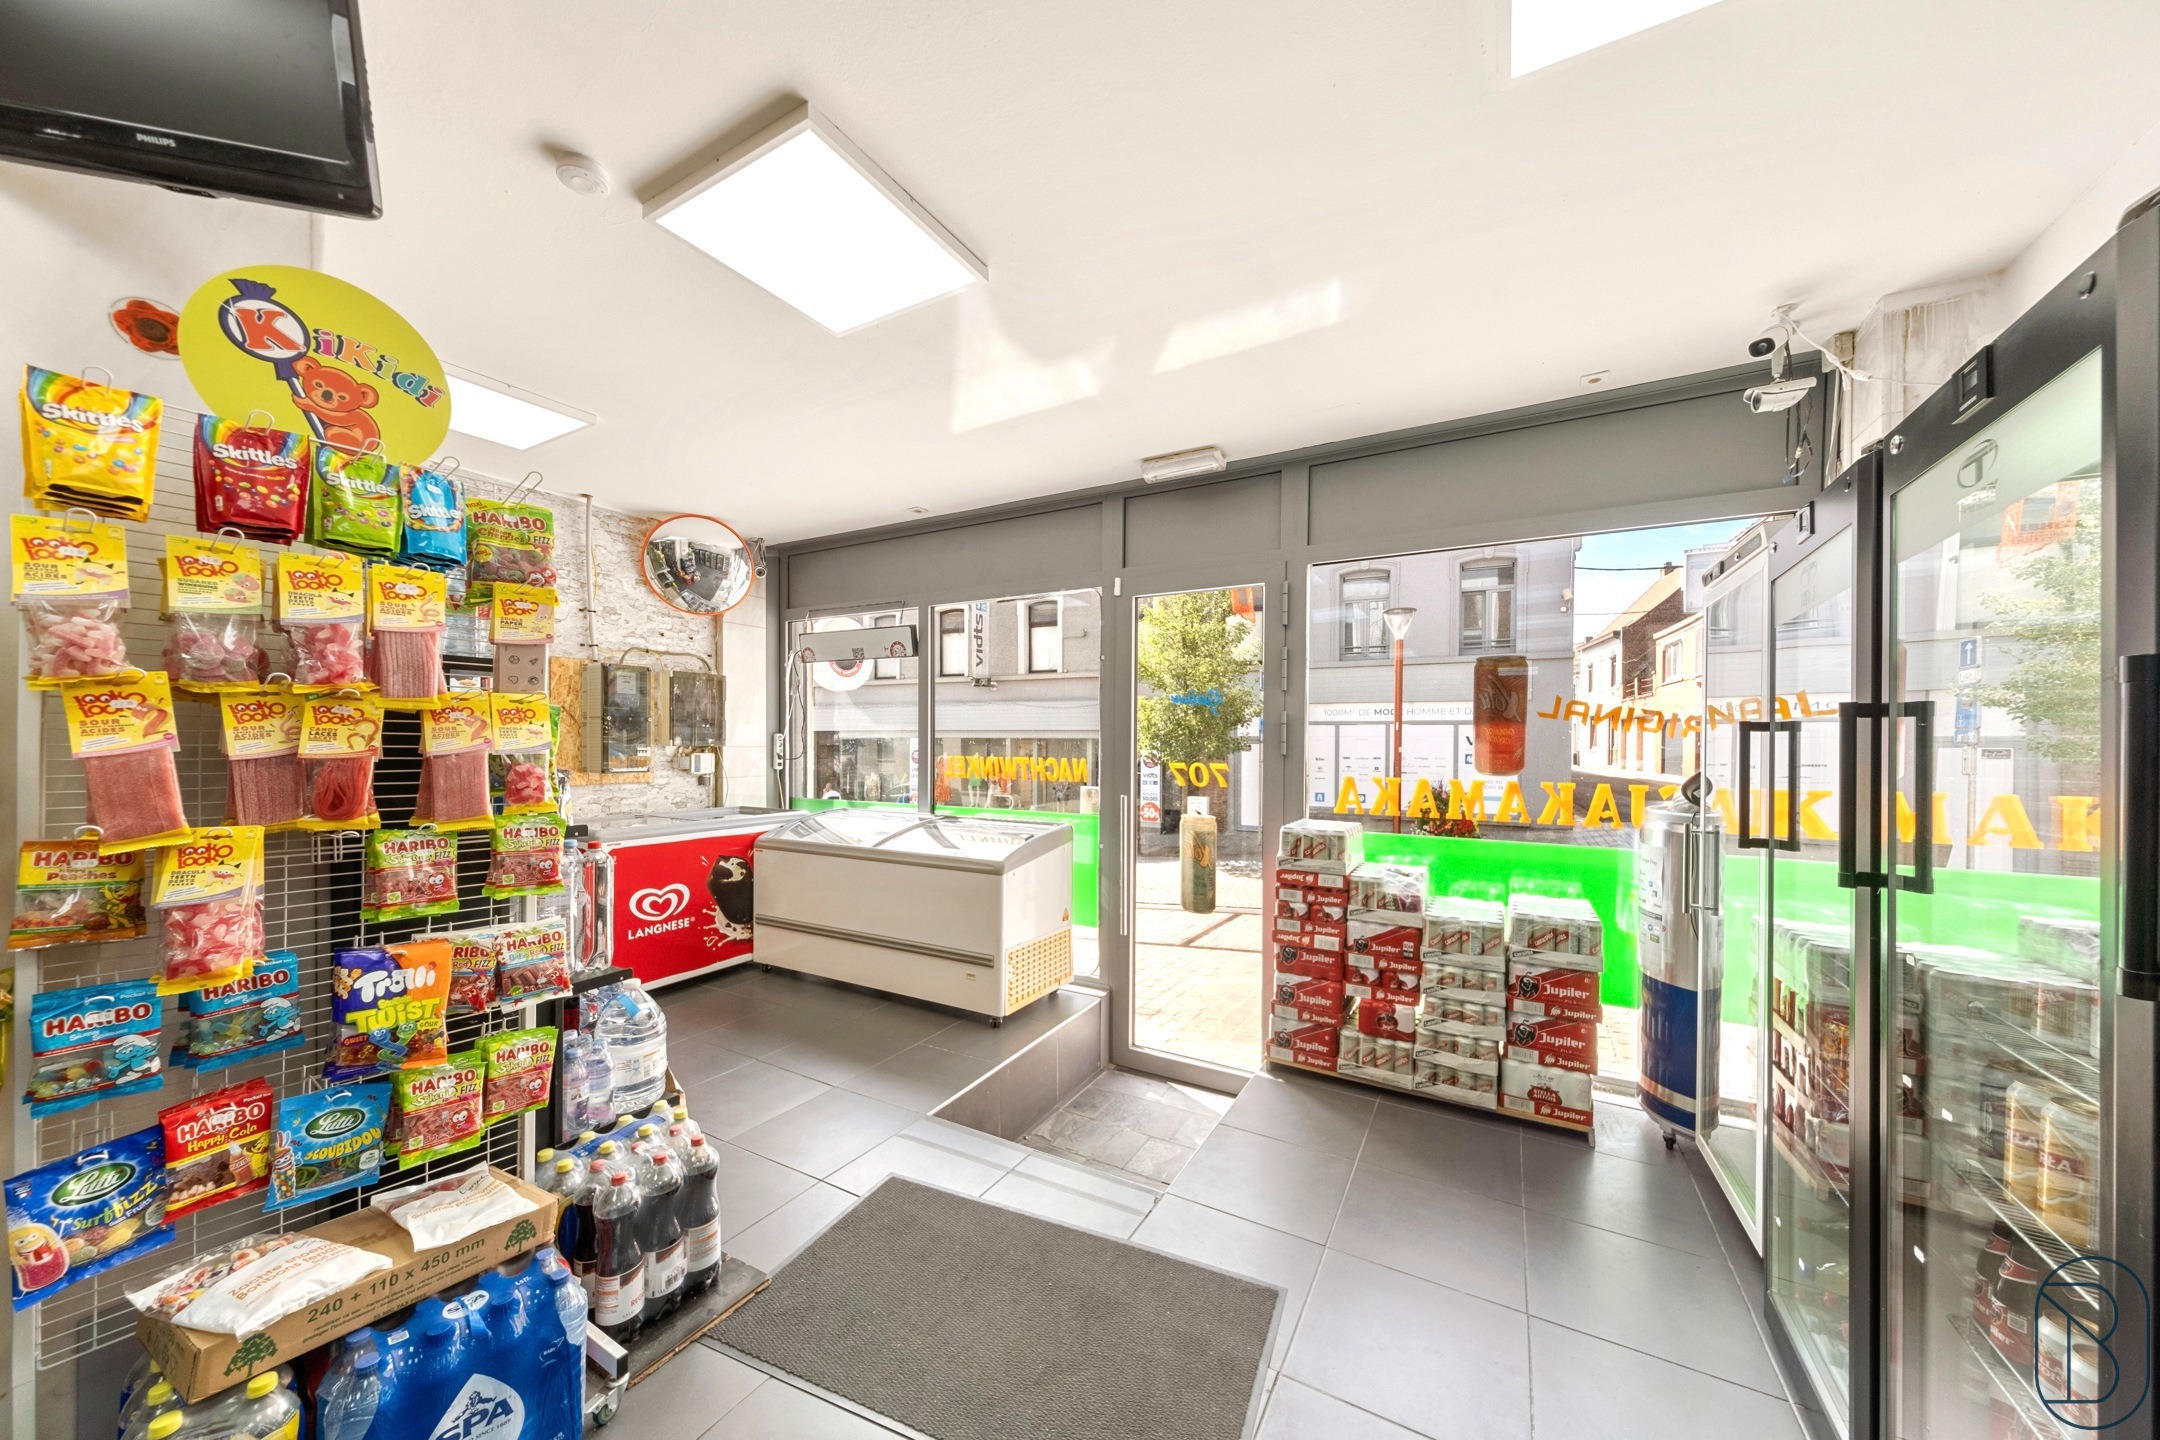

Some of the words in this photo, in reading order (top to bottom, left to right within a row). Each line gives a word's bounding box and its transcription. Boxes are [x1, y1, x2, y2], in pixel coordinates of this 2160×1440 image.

[136, 133, 177, 148] PHILIPS
[40, 402, 144, 433] Skittles
[212, 442, 298, 470] Skittles
[326, 472, 397, 496] Skittles
[472, 511, 546, 531] HARIBO
[476, 529, 525, 543] Cherries
[24, 572, 67, 580] ACIDES
[380, 607, 412, 616] ACIDES
[975, 610, 985, 667] vidts
[1358, 708, 1371, 716] DE
[1374, 708, 1403, 716] MOD
[1406, 707, 1446, 715] HOMME
[1450, 707, 1461, 715] ET
[79, 718, 120, 726] SOUR
[80, 727, 126, 735] ACIDES
[234, 731, 272, 739] ACIDES
[384, 837, 449, 854] HARIBO
[46, 870, 117, 881] Peaches
[1280, 873, 1305, 882] Jupiler
[1315, 894, 1343, 905] Jupiler
[628, 918, 690, 941] LANGNESE
[1314, 925, 1341, 935] Jupiler
[1276, 933, 1300, 943] Jupiler
[530, 948, 545, 957] Red
[1371, 943, 1401, 954] Jupiler
[1300, 951, 1336, 965] Jupiler
[1389, 961, 1418, 971] Jupiler
[202, 968, 291, 1002] HARIBO
[354, 960, 437, 1003] Trolli
[119, 991, 147, 1000] Pocket
[1386, 992, 1414, 1004] Jupiler
[1543, 985, 1590, 999] Jupiler
[1299, 993, 1333, 1007] Jupiler
[1311, 1015, 1337, 1025] Jupiler
[1563, 1009, 1597, 1020] Jupiler
[420, 1020, 440, 1028] SOUR
[343, 1034, 369, 1046] SWEET
[1294, 1039, 1330, 1053] Jupiler
[1539, 1033, 1586, 1049] Jupiler
[1306, 1056, 1332, 1068] Jupiler
[1557, 1057, 1591, 1070] Jupiler
[242, 1094, 262, 1103] Pocket
[1533, 1088, 1556, 1098] STELLA
[1533, 1094, 1557, 1103] ARTOIS
[314, 1109, 357, 1132] Lutti
[1552, 1109, 1587, 1122] Jupiler
[187, 1133, 225, 1153] Happy
[228, 1123, 258, 1143] Cola
[304, 1127, 383, 1160] SCOUBIDOU
[61, 1167, 124, 1204] Lutti
[126, 1198, 153, 1219] Fruits
[227, 1263, 283, 1297] Zachte
[235, 1260, 303, 1301] Bonbons
[307, 1298, 347, 1324] 240
[350, 1290, 362, 1302] +
[369, 1274, 398, 1296] 110
[421, 1250, 451, 1275] 450
[455, 1238, 486, 1257] mm
[436, 1398, 514, 1440] SPA
